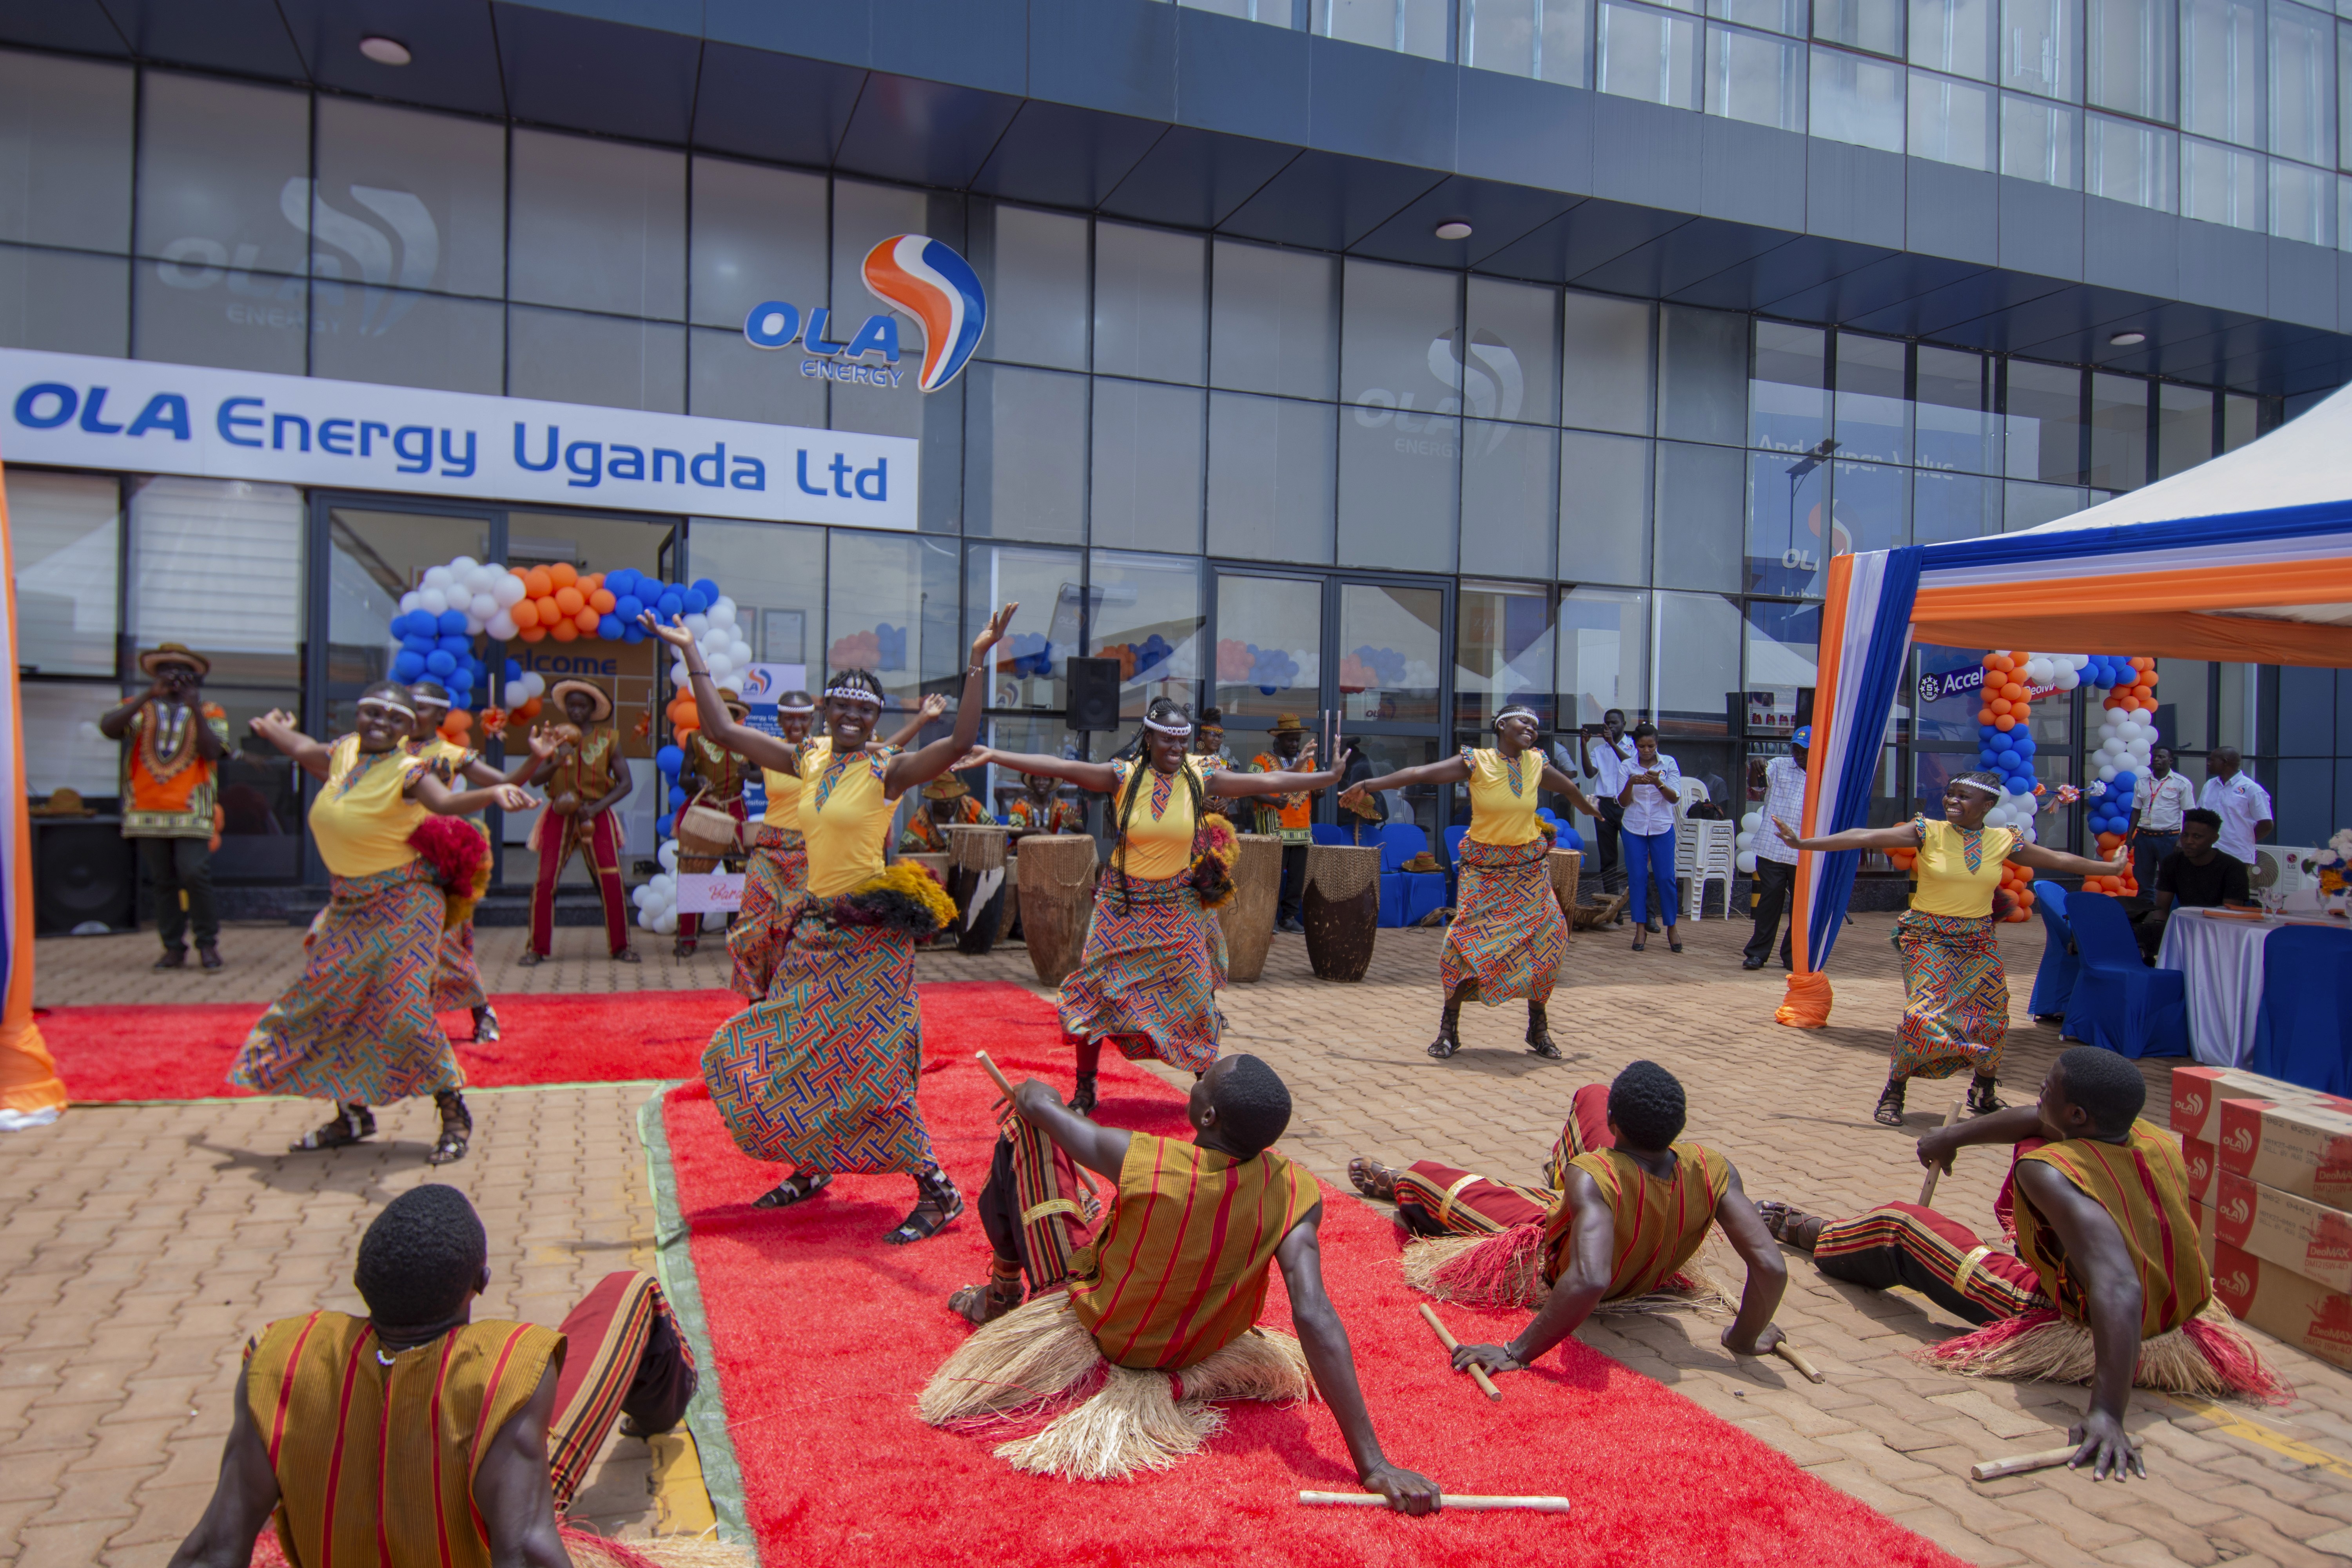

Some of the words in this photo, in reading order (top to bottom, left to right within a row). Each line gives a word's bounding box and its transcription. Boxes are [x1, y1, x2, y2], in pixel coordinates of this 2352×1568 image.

[158, 236, 345, 307] OLA
[744, 300, 900, 364] OLA
[800, 359, 905, 388] ENERGY
[1354, 388, 1463, 438] OLA
[14, 383, 192, 441] OLA
[217, 396, 477, 477] Energy
[513, 421, 766, 490] Uganda
[796, 449, 887, 502] Ltd
[2174, 1100, 2193, 1112] OLA
[2223, 1136, 2242, 1149] OLA
[2220, 1205, 2238, 1219] OLA
[2310, 1246, 2350, 1258] DeoMAX
[2220, 1277, 2239, 1291] OLA
